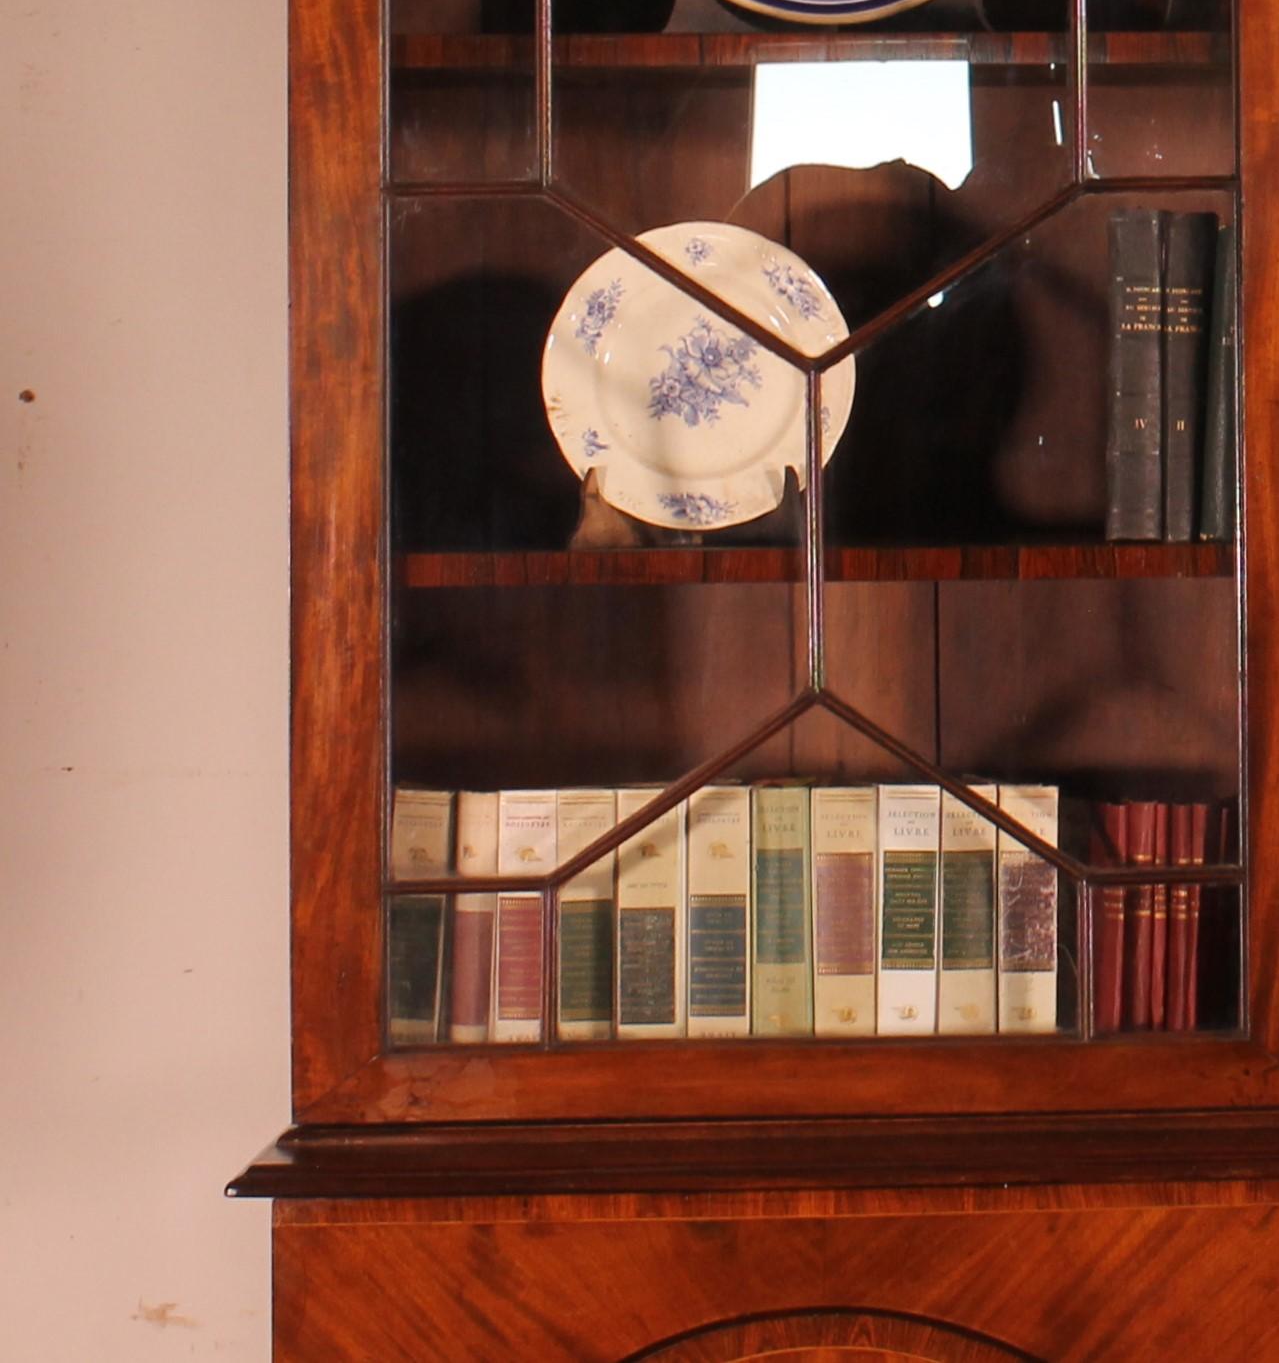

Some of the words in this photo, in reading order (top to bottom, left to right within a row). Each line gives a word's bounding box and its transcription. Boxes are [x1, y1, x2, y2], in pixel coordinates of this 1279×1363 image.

[1135, 418, 1149, 430] IV
[1176, 420, 1185, 431] II
[894, 827, 930, 836] LIVRE
[952, 827, 986, 836] LIVRE
